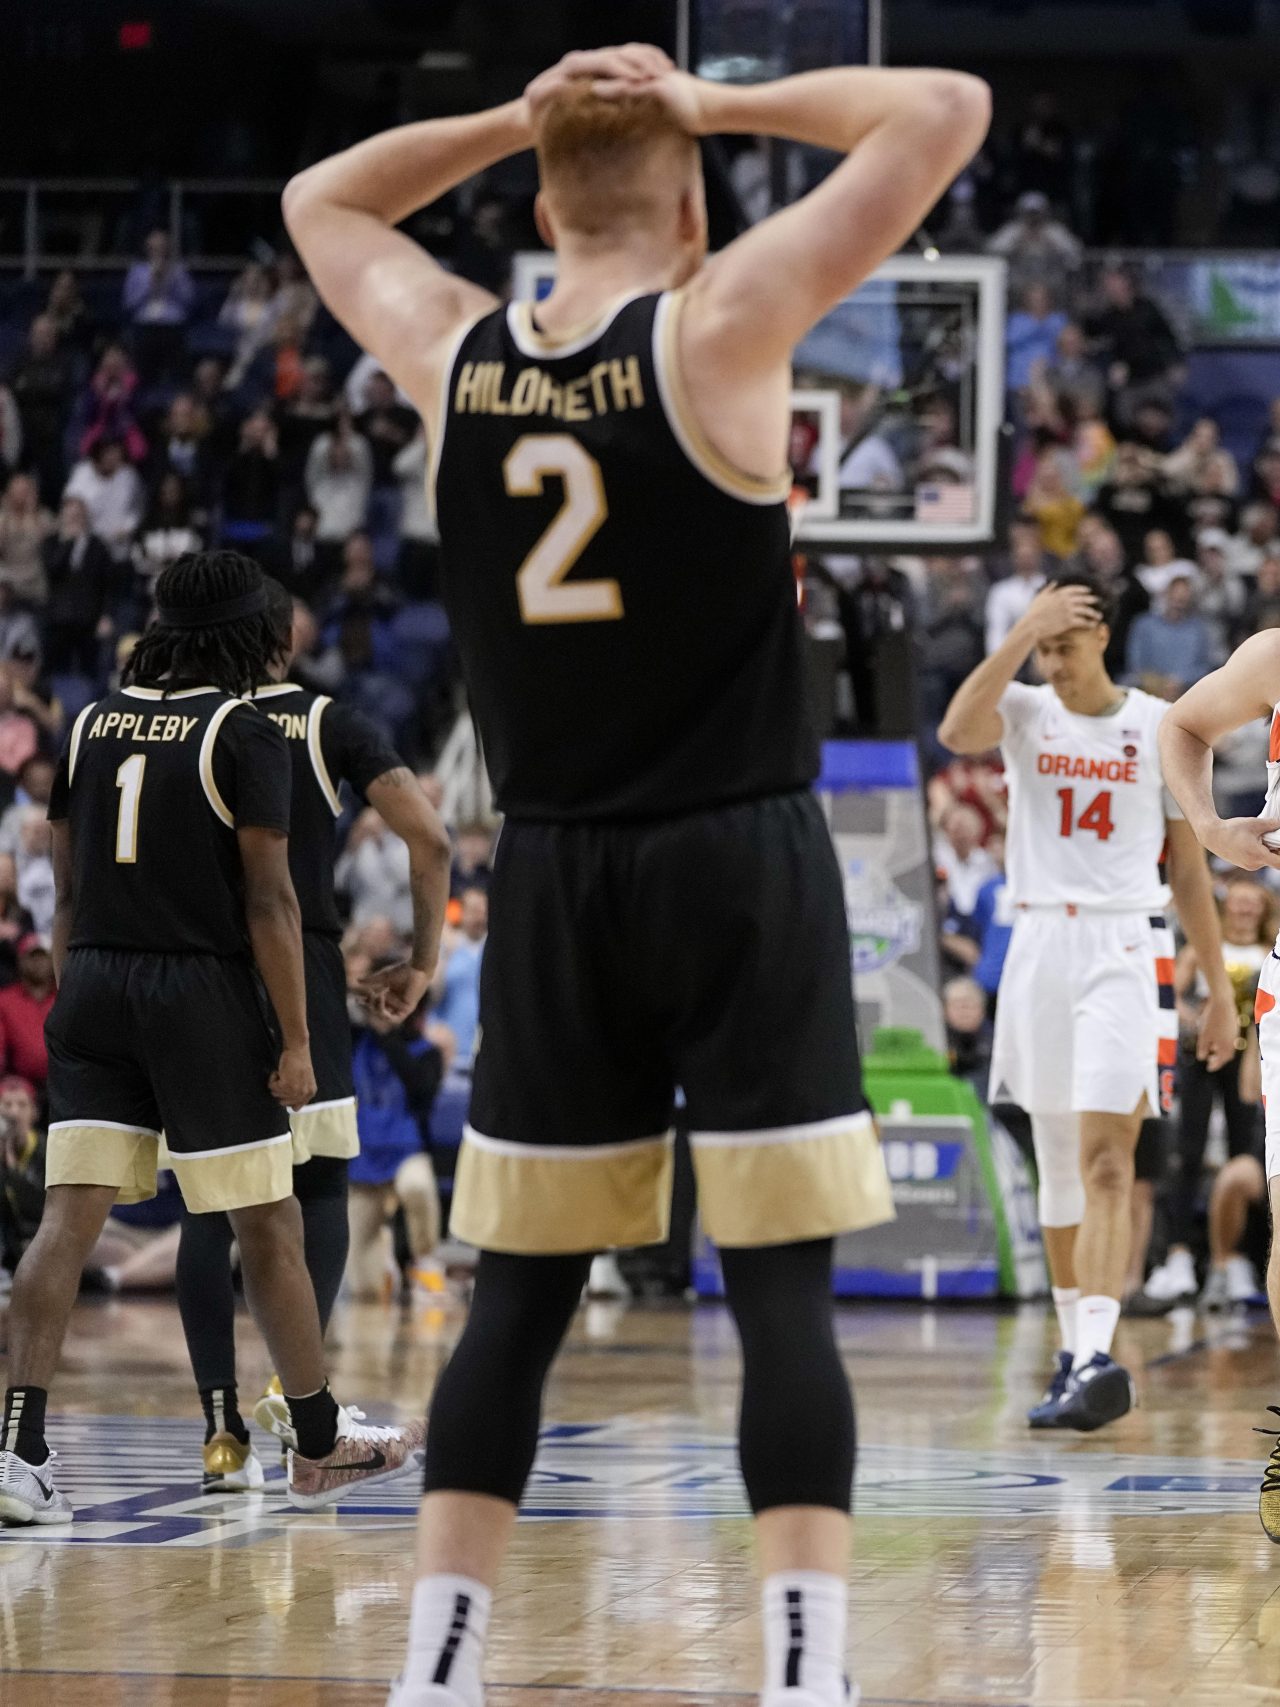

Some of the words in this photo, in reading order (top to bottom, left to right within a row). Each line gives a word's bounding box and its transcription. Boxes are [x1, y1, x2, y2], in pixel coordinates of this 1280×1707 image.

[455, 355, 645, 421] HILDRETH
[503, 433, 625, 625] 2
[88, 712, 199, 742] APPLEBY
[1037, 753, 1139, 783] ORANGE
[115, 754, 147, 864] 1
[1056, 787, 1115, 841] 14
